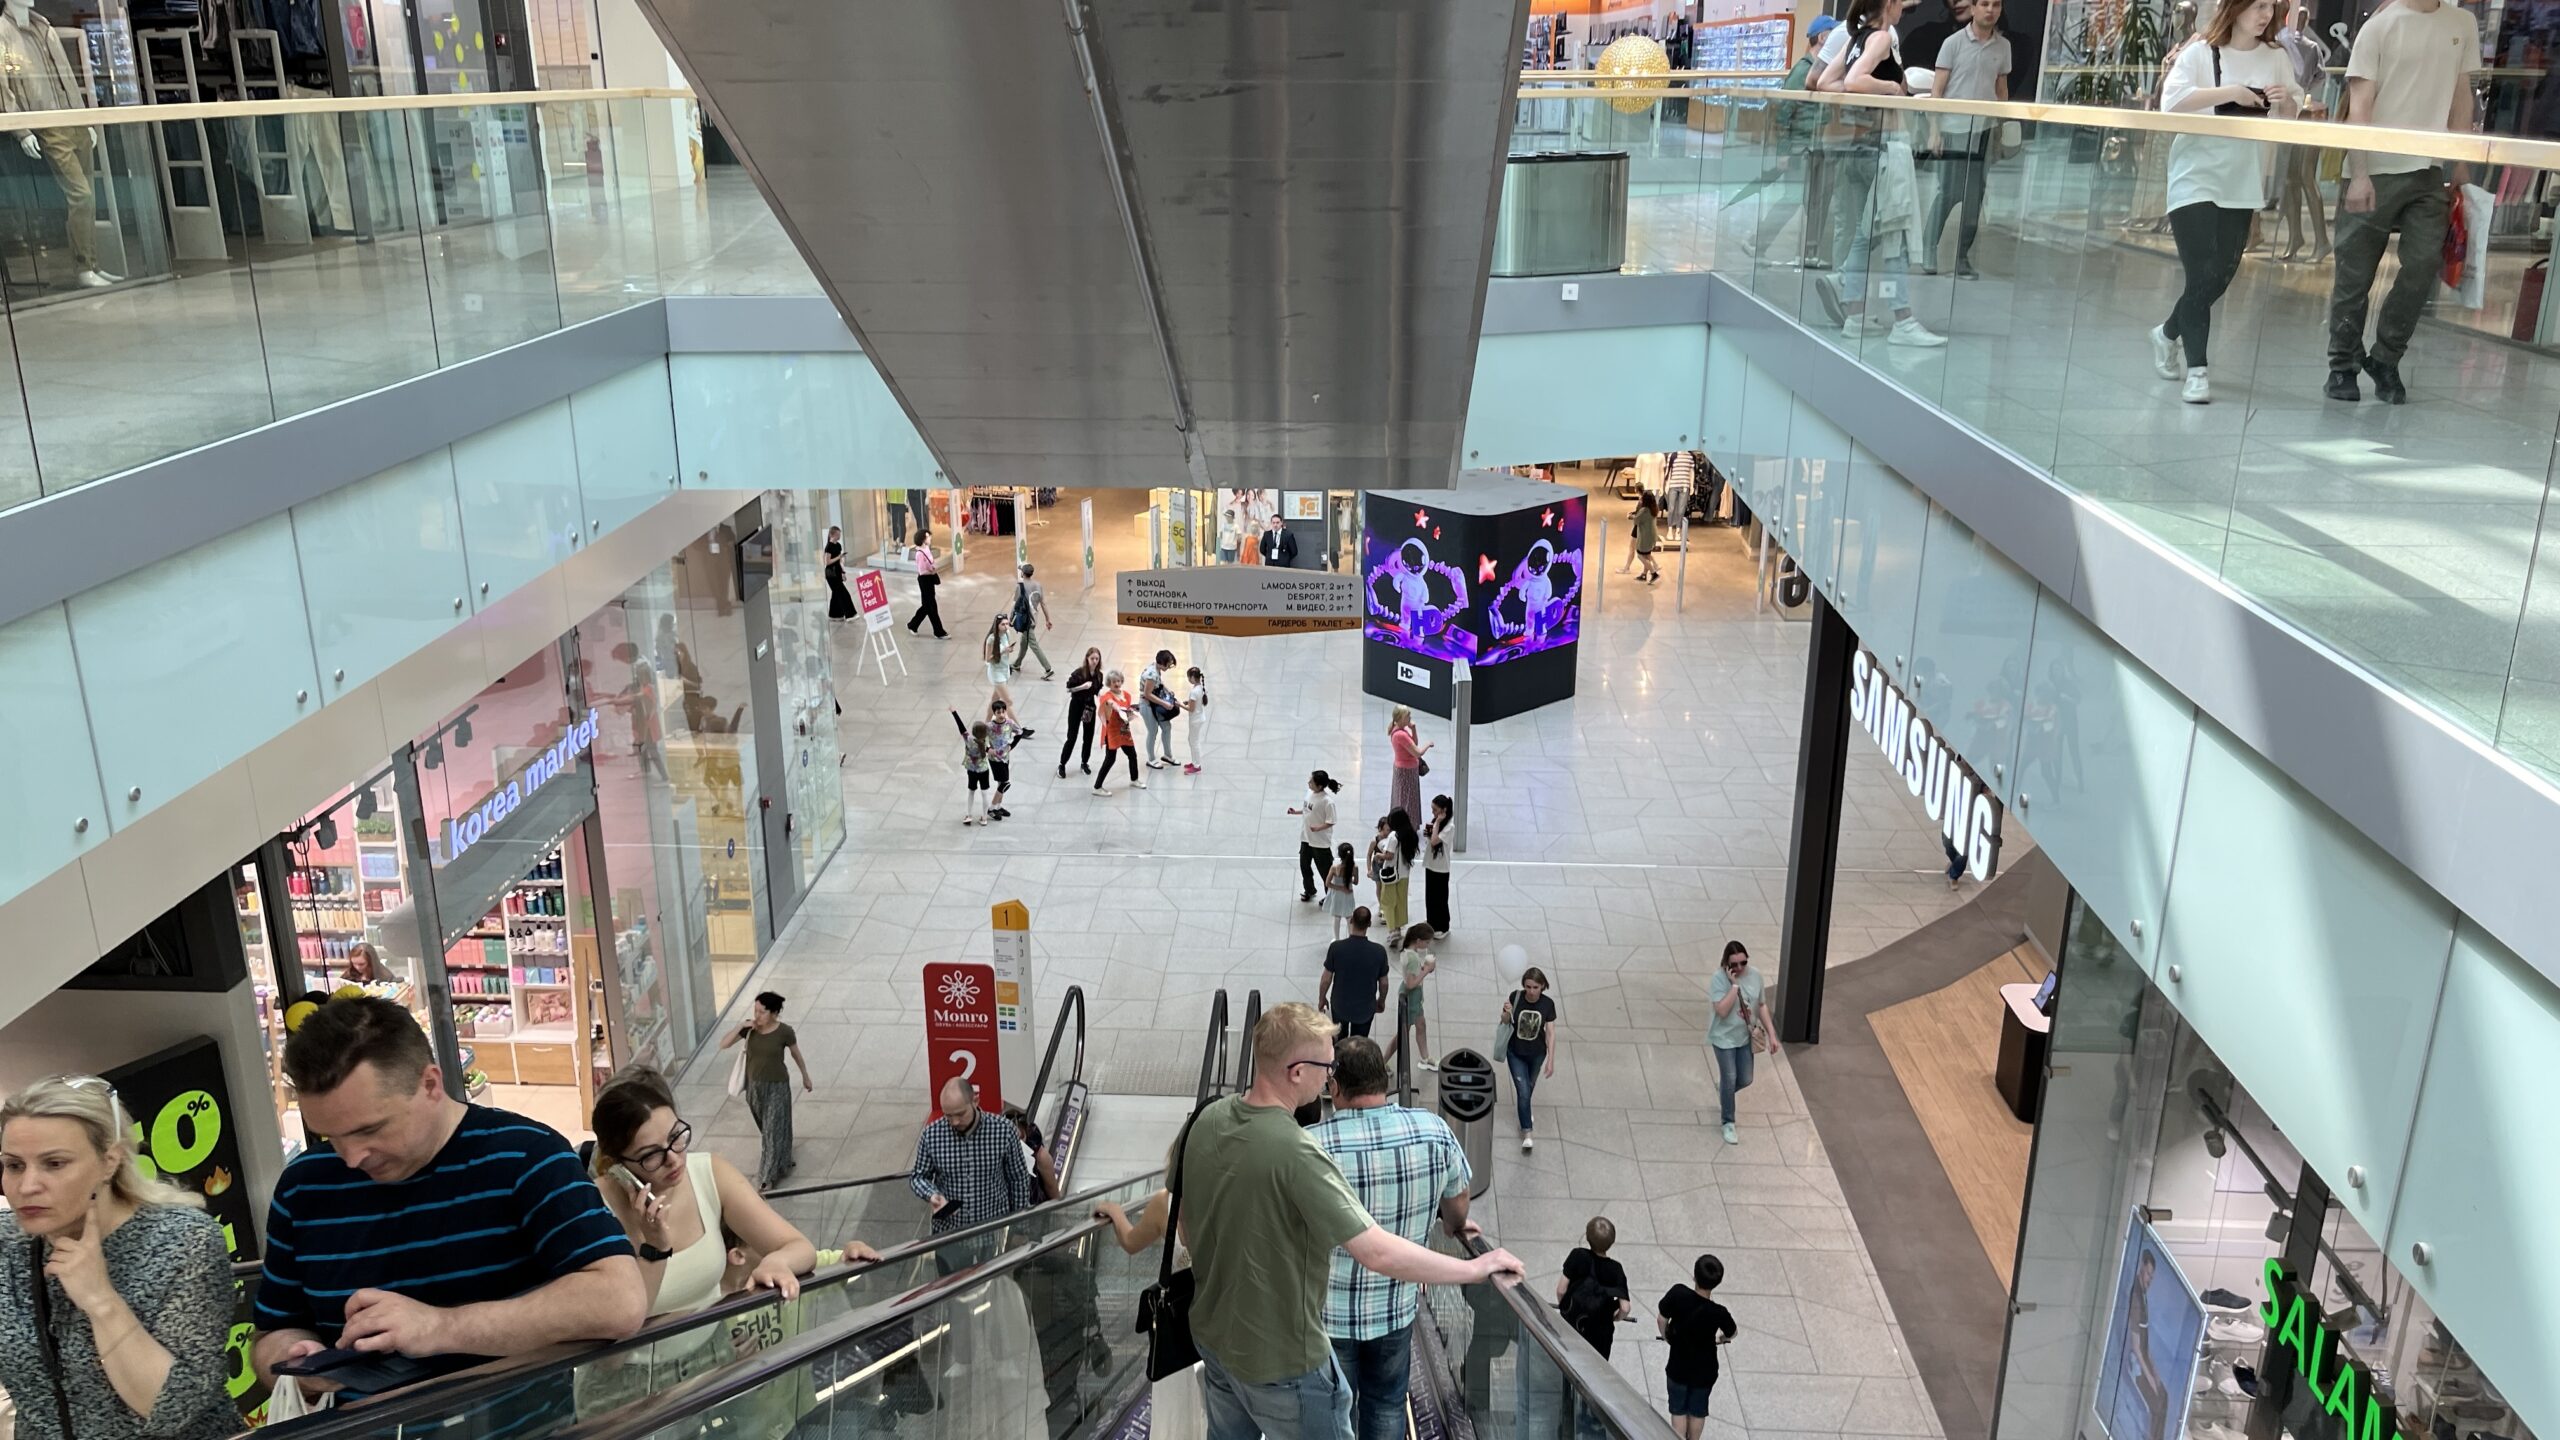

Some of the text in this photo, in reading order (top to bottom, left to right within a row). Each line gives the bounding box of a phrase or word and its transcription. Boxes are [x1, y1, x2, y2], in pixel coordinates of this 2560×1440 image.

[859, 579, 873, 590] Kids
[1136, 580, 1165, 588] ВЫХОД
[1261, 582, 1297, 590] LAMODA
[1298, 582, 1328, 591] SPORT,
[861, 590, 873, 599] Fun
[1136, 590, 1188, 598] ОСТАНОВКА
[1287, 593, 1328, 602] DESPORT,
[863, 597, 878, 608] Fest
[1136, 600, 1268, 611] ОБЩЕСТВЕННОГО ТРАНСПОРТА
[1137, 616, 1178, 625] ПАРКОВКА
[1268, 619, 1343, 628] ГАРДЕРОБ ТУАЛЕТ
[1851, 650, 1993, 881] SAMSUNG
[450, 707, 599, 860] korea market
[1003, 909, 1009, 926] 1
[934, 1009, 988, 1023] Monro
[949, 1049, 980, 1092] 2
